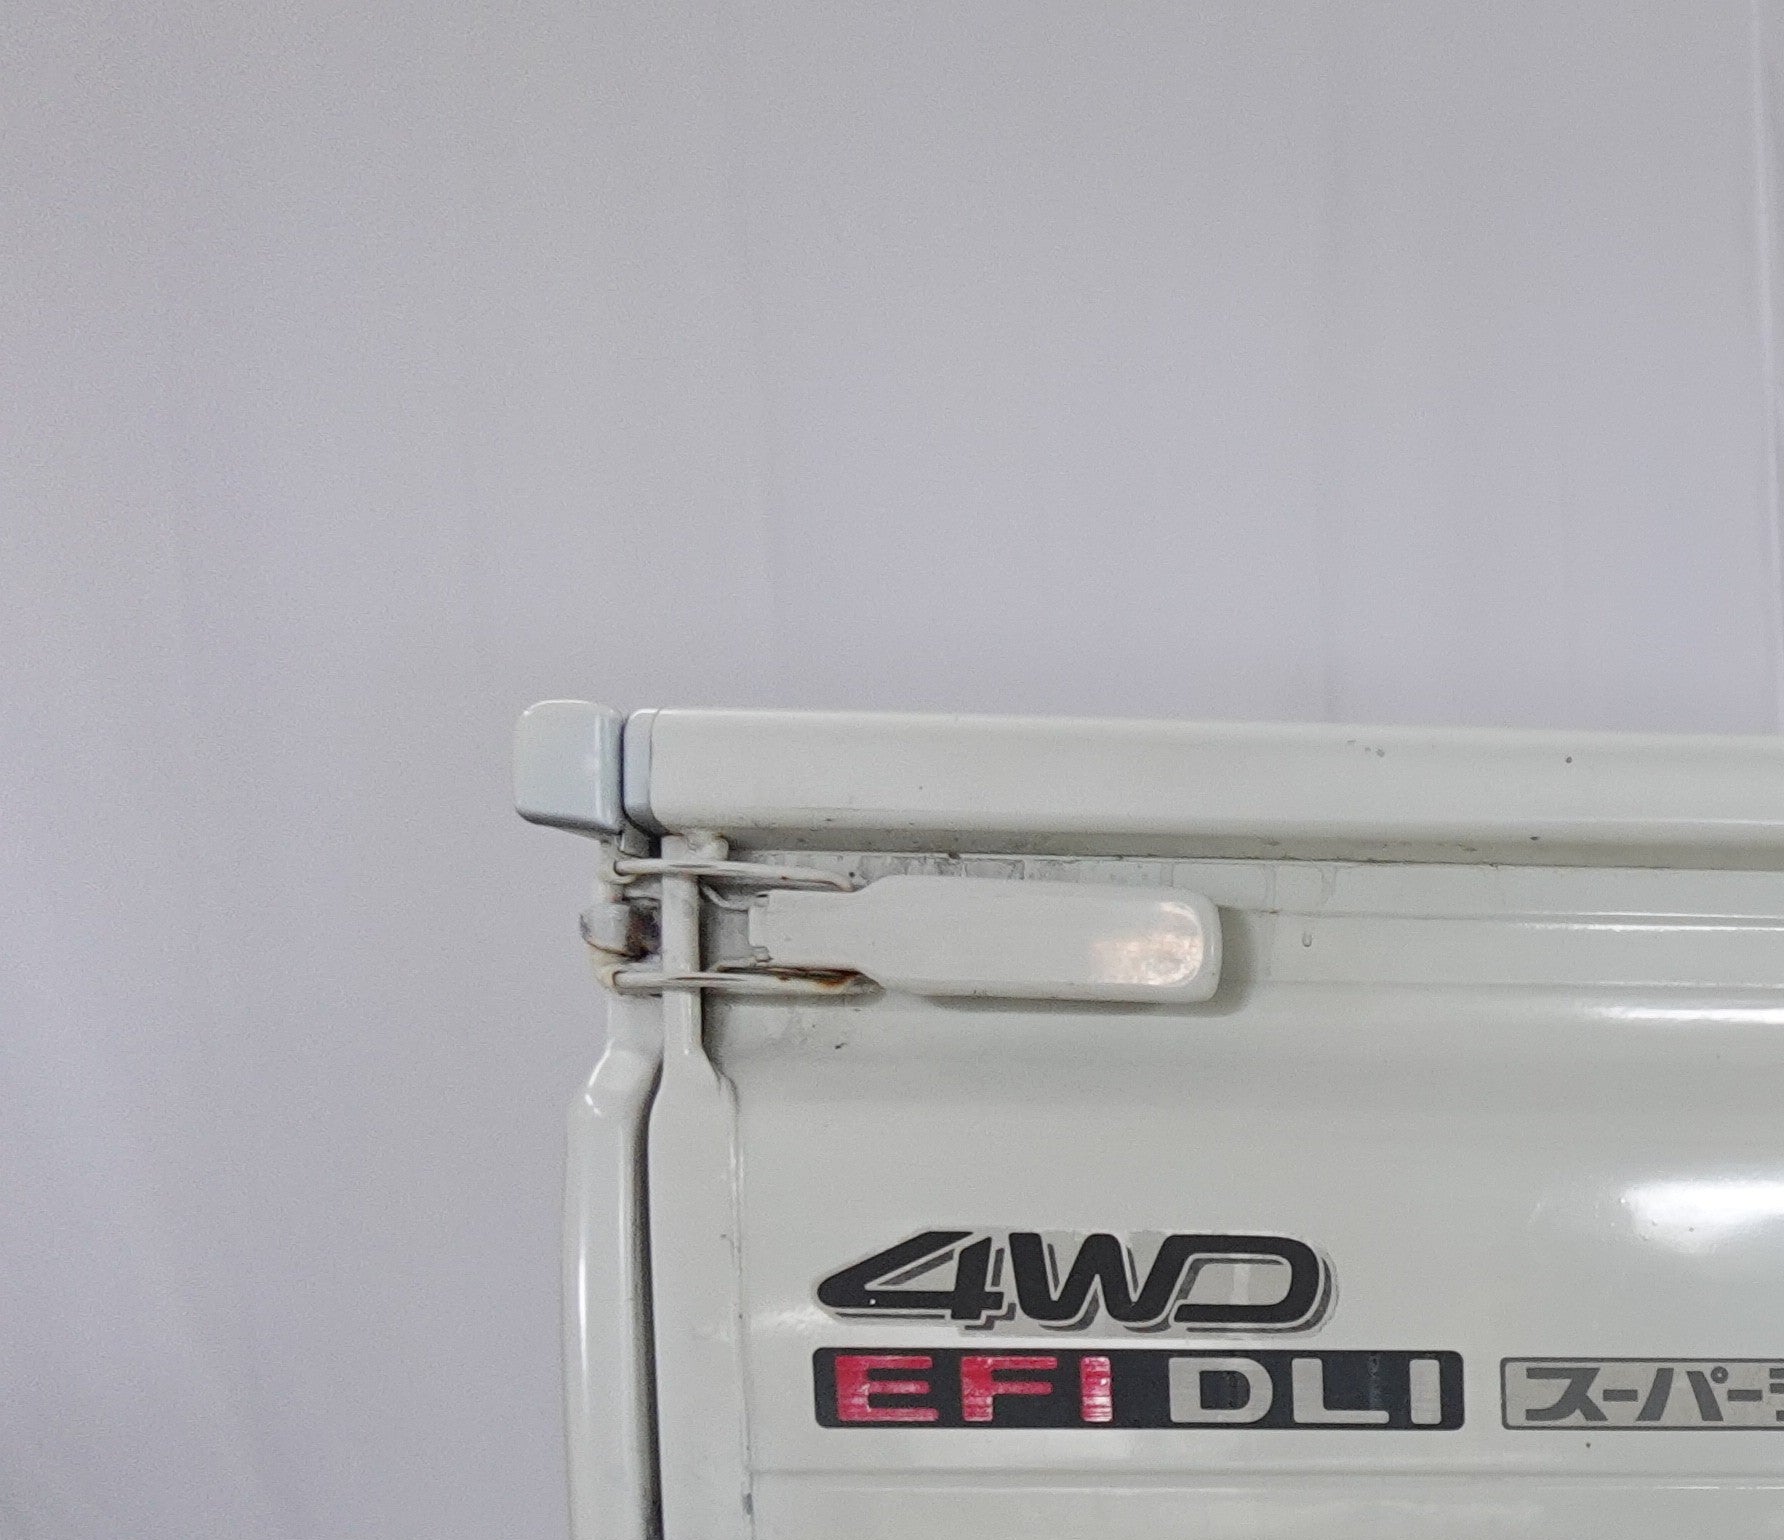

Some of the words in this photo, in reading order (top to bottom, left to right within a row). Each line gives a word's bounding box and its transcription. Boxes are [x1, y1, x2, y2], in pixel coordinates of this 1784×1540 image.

[816, 1231, 1336, 1334] 4WD
[834, 1354, 1114, 1422] EFI
[1168, 1356, 1442, 1425] DLI
